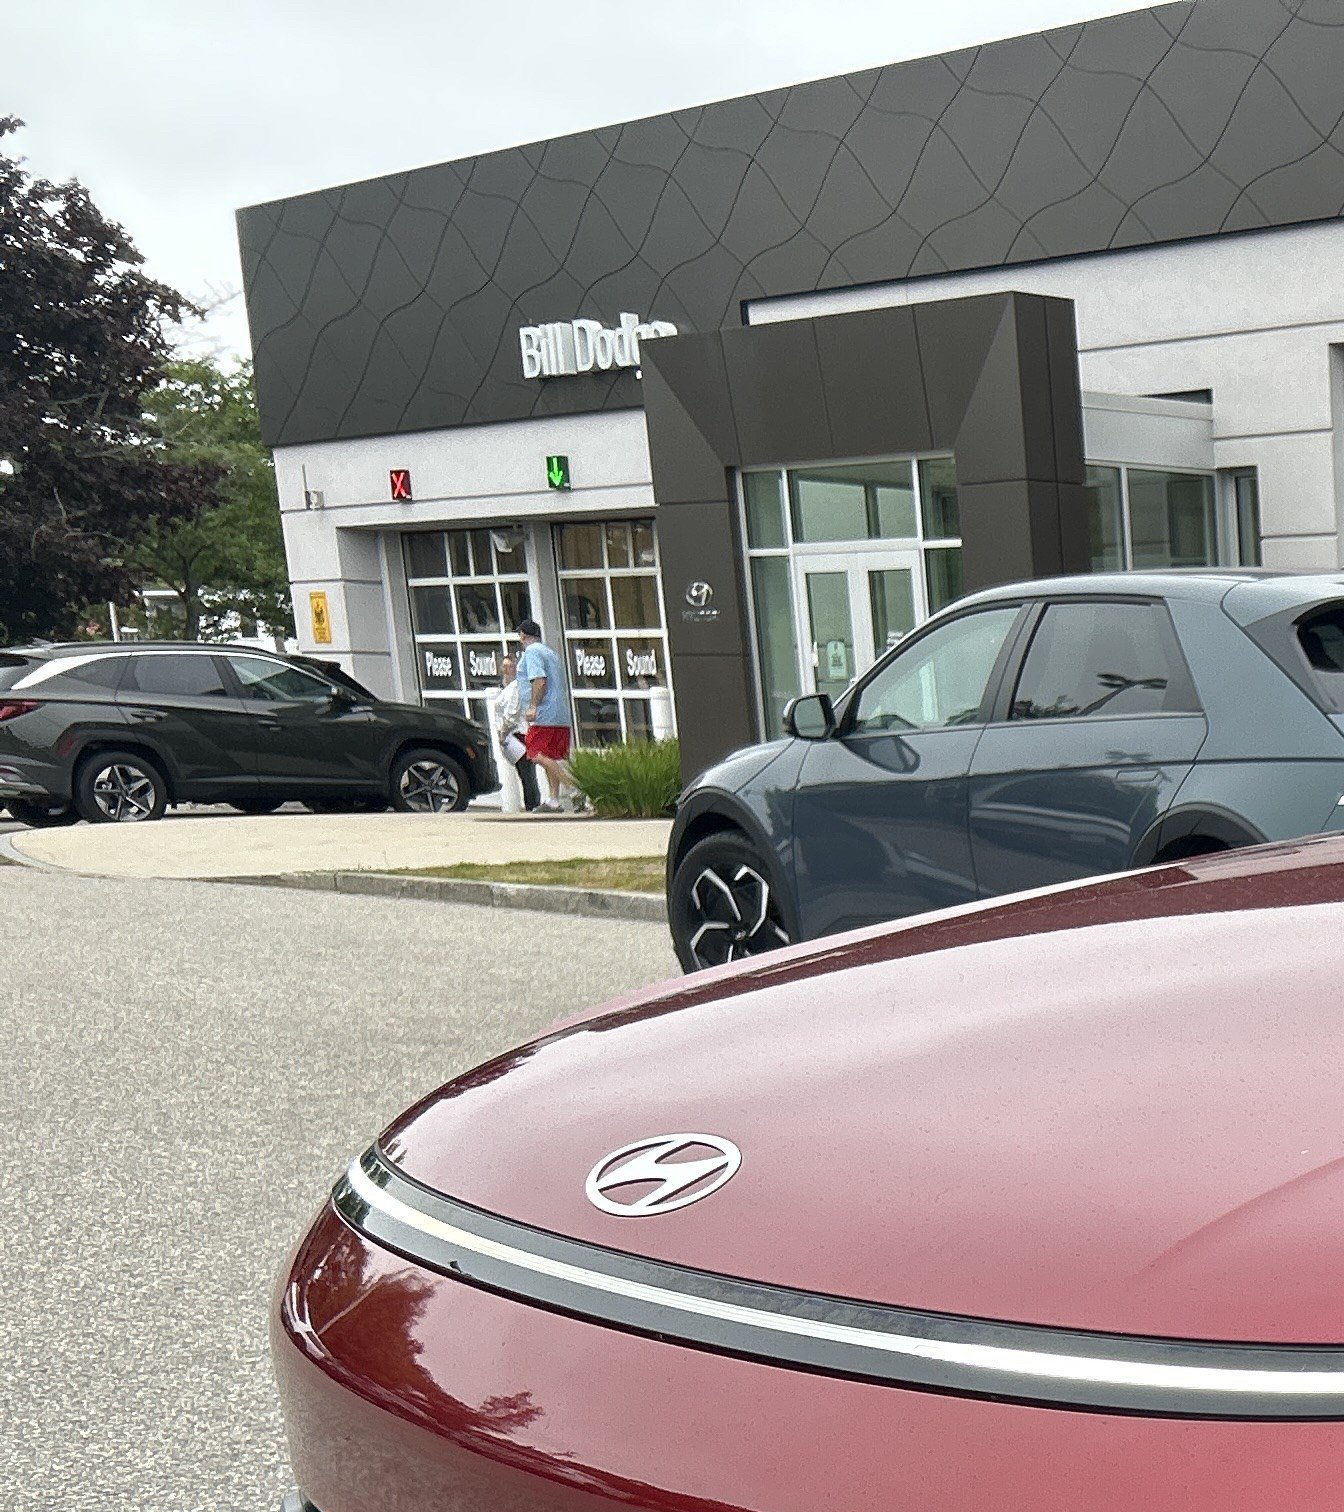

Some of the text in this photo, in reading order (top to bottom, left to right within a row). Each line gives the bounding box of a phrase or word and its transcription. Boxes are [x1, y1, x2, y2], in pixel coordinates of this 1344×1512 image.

[519, 312, 678, 380] Bill Dod
[425, 651, 452, 677] Please
[469, 649, 497, 676] Sound
[575, 648, 658, 677] Please Sound
